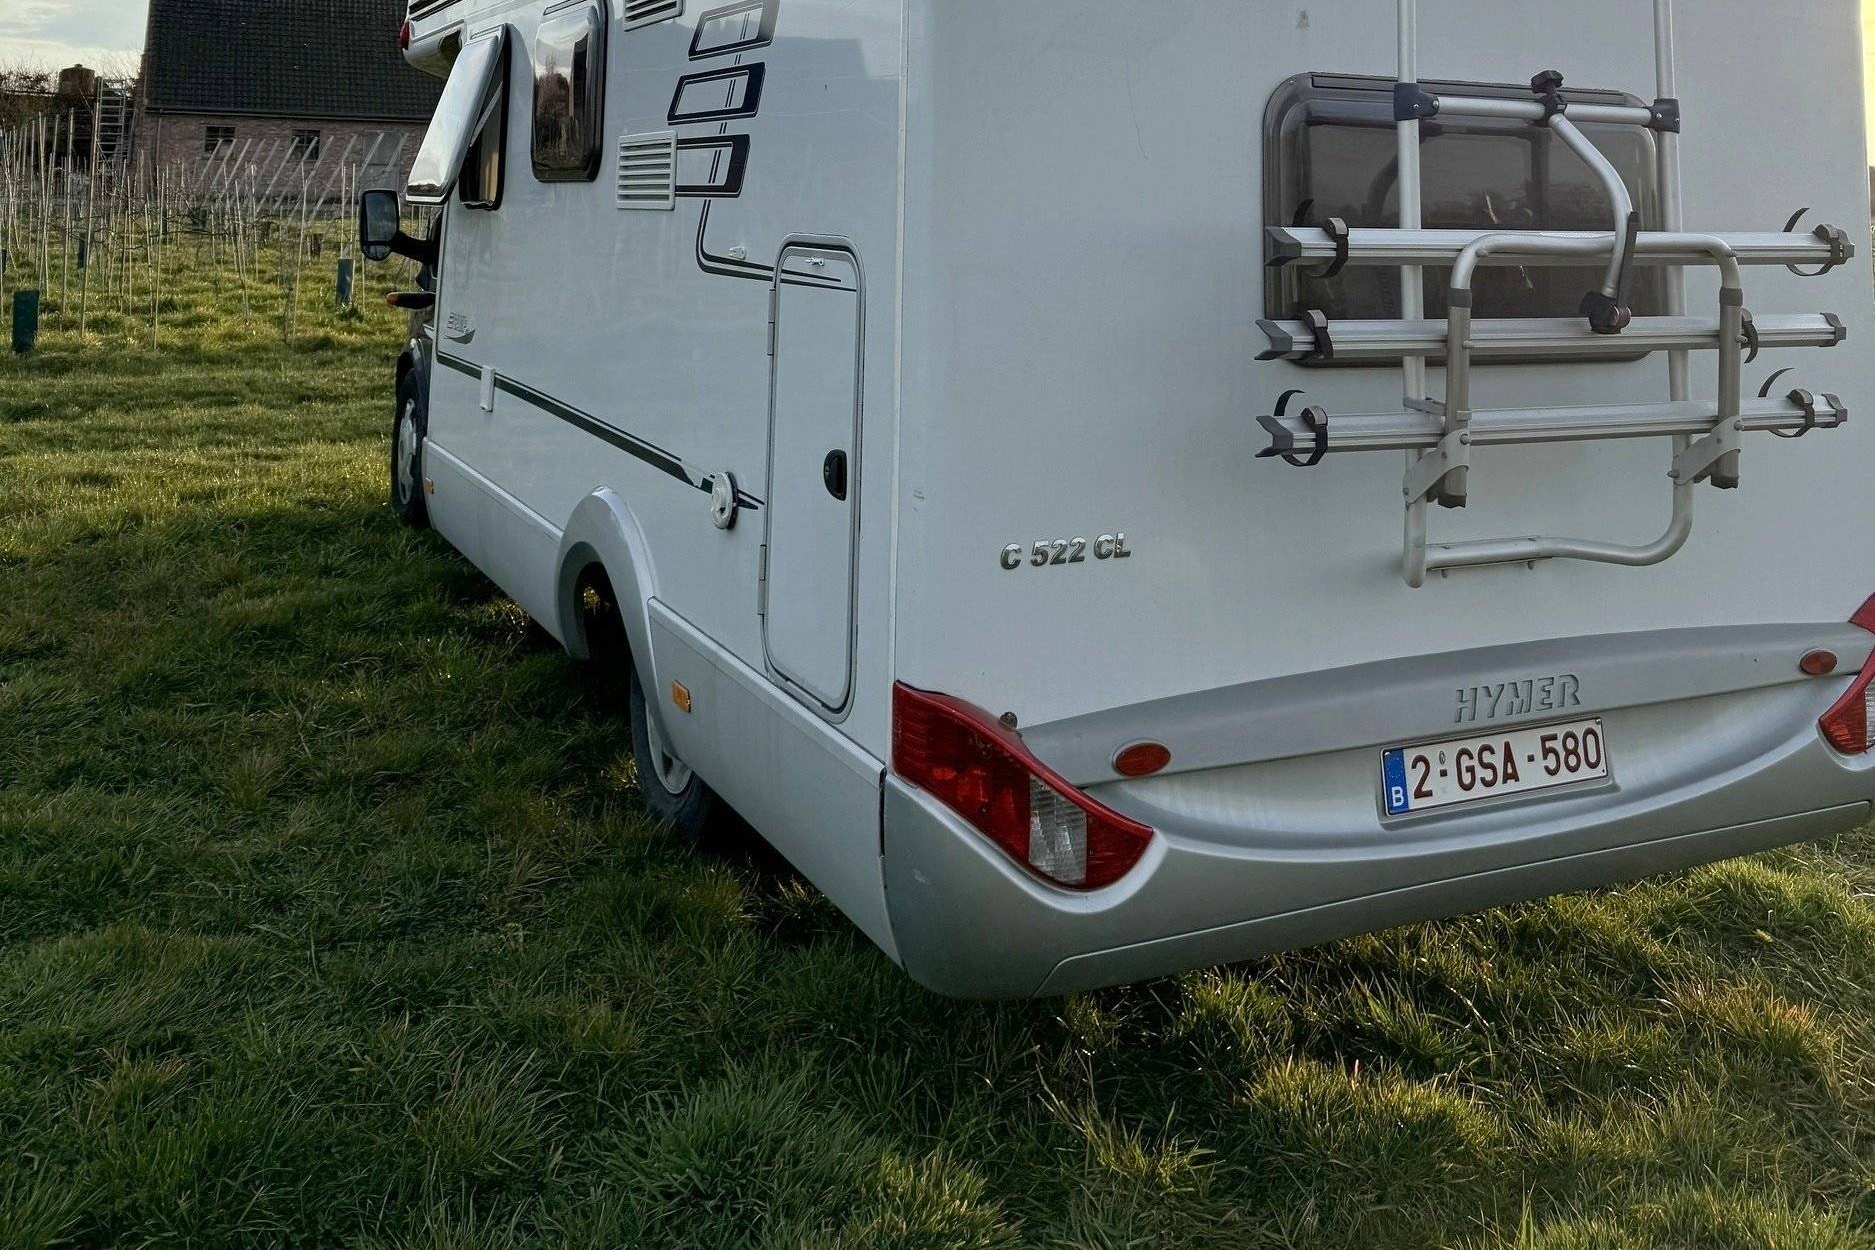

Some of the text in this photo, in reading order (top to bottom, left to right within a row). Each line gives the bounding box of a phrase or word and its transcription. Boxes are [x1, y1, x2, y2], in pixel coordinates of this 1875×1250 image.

[1000, 531, 1132, 571] C 522 CL
[1454, 673, 1581, 724] HYMER
[1391, 786, 1405, 807] B
